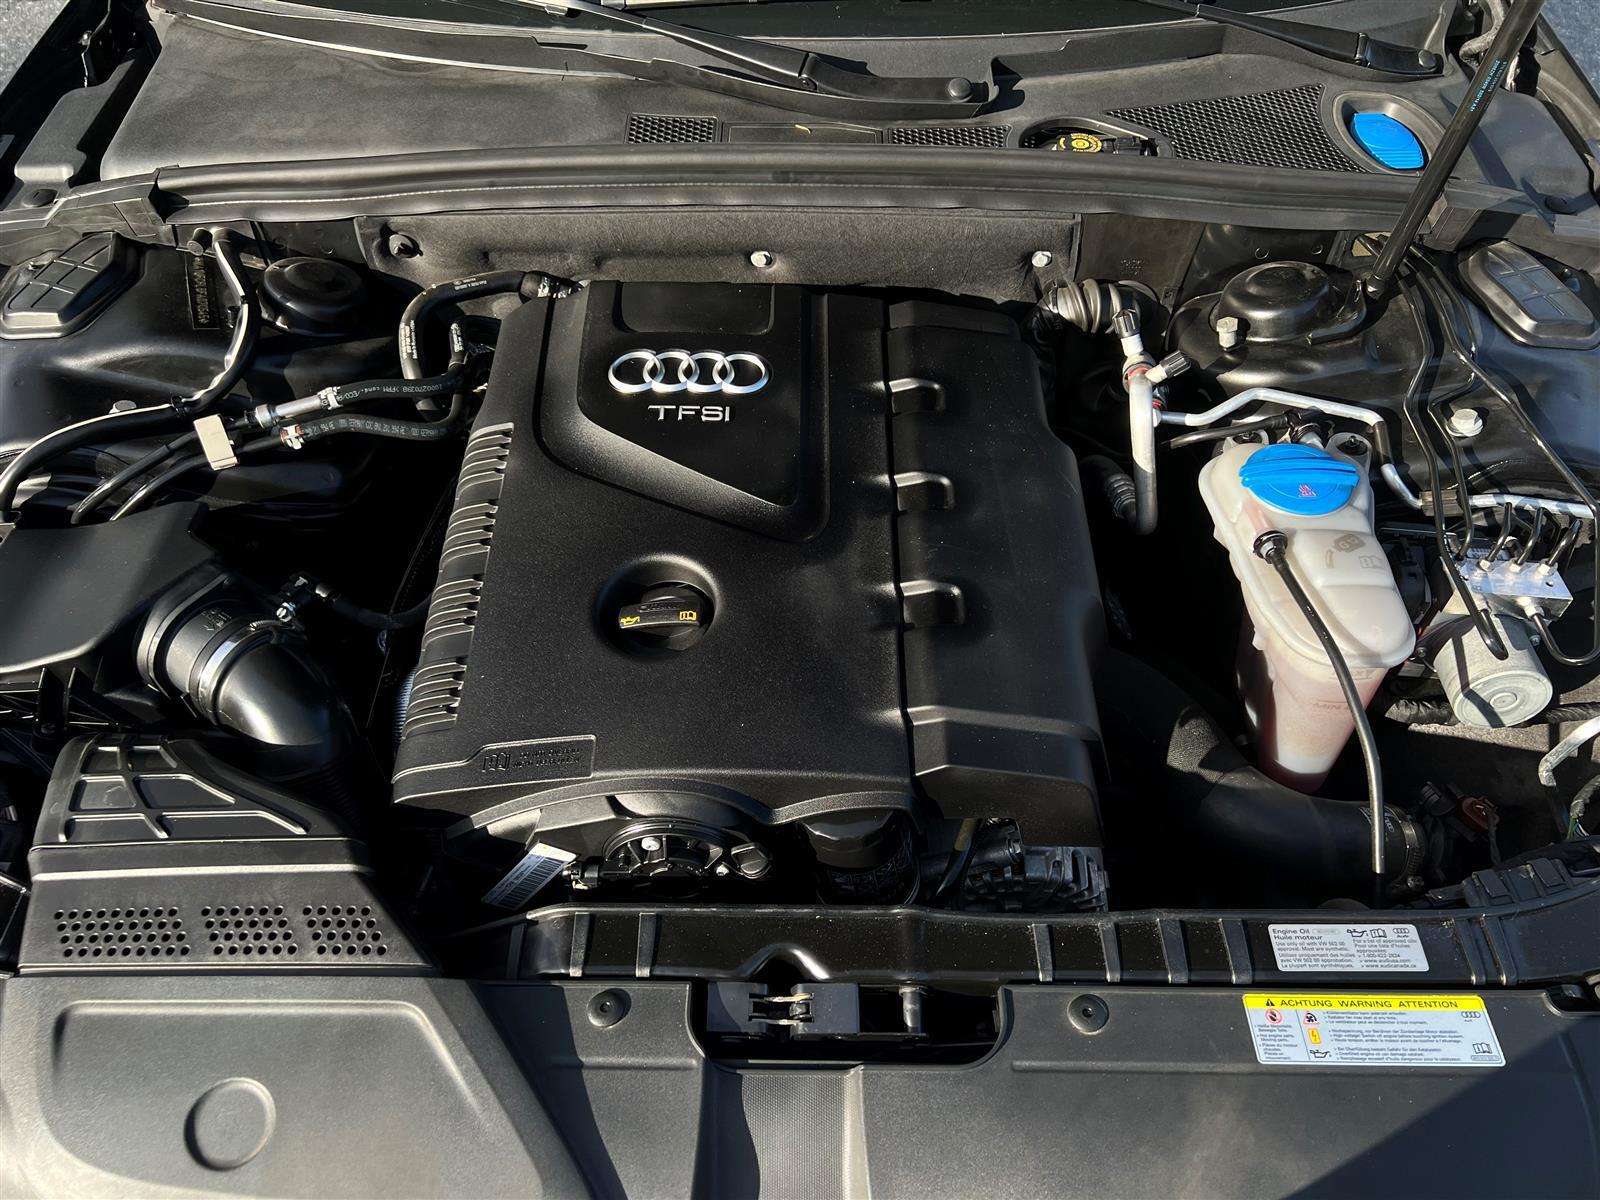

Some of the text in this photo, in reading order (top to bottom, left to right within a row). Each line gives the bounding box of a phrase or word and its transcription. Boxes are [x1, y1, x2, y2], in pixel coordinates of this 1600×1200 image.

[648, 405, 731, 422] TFSI
[1280, 999, 1458, 1008] ACHTUNG WARNING ATTENTION
